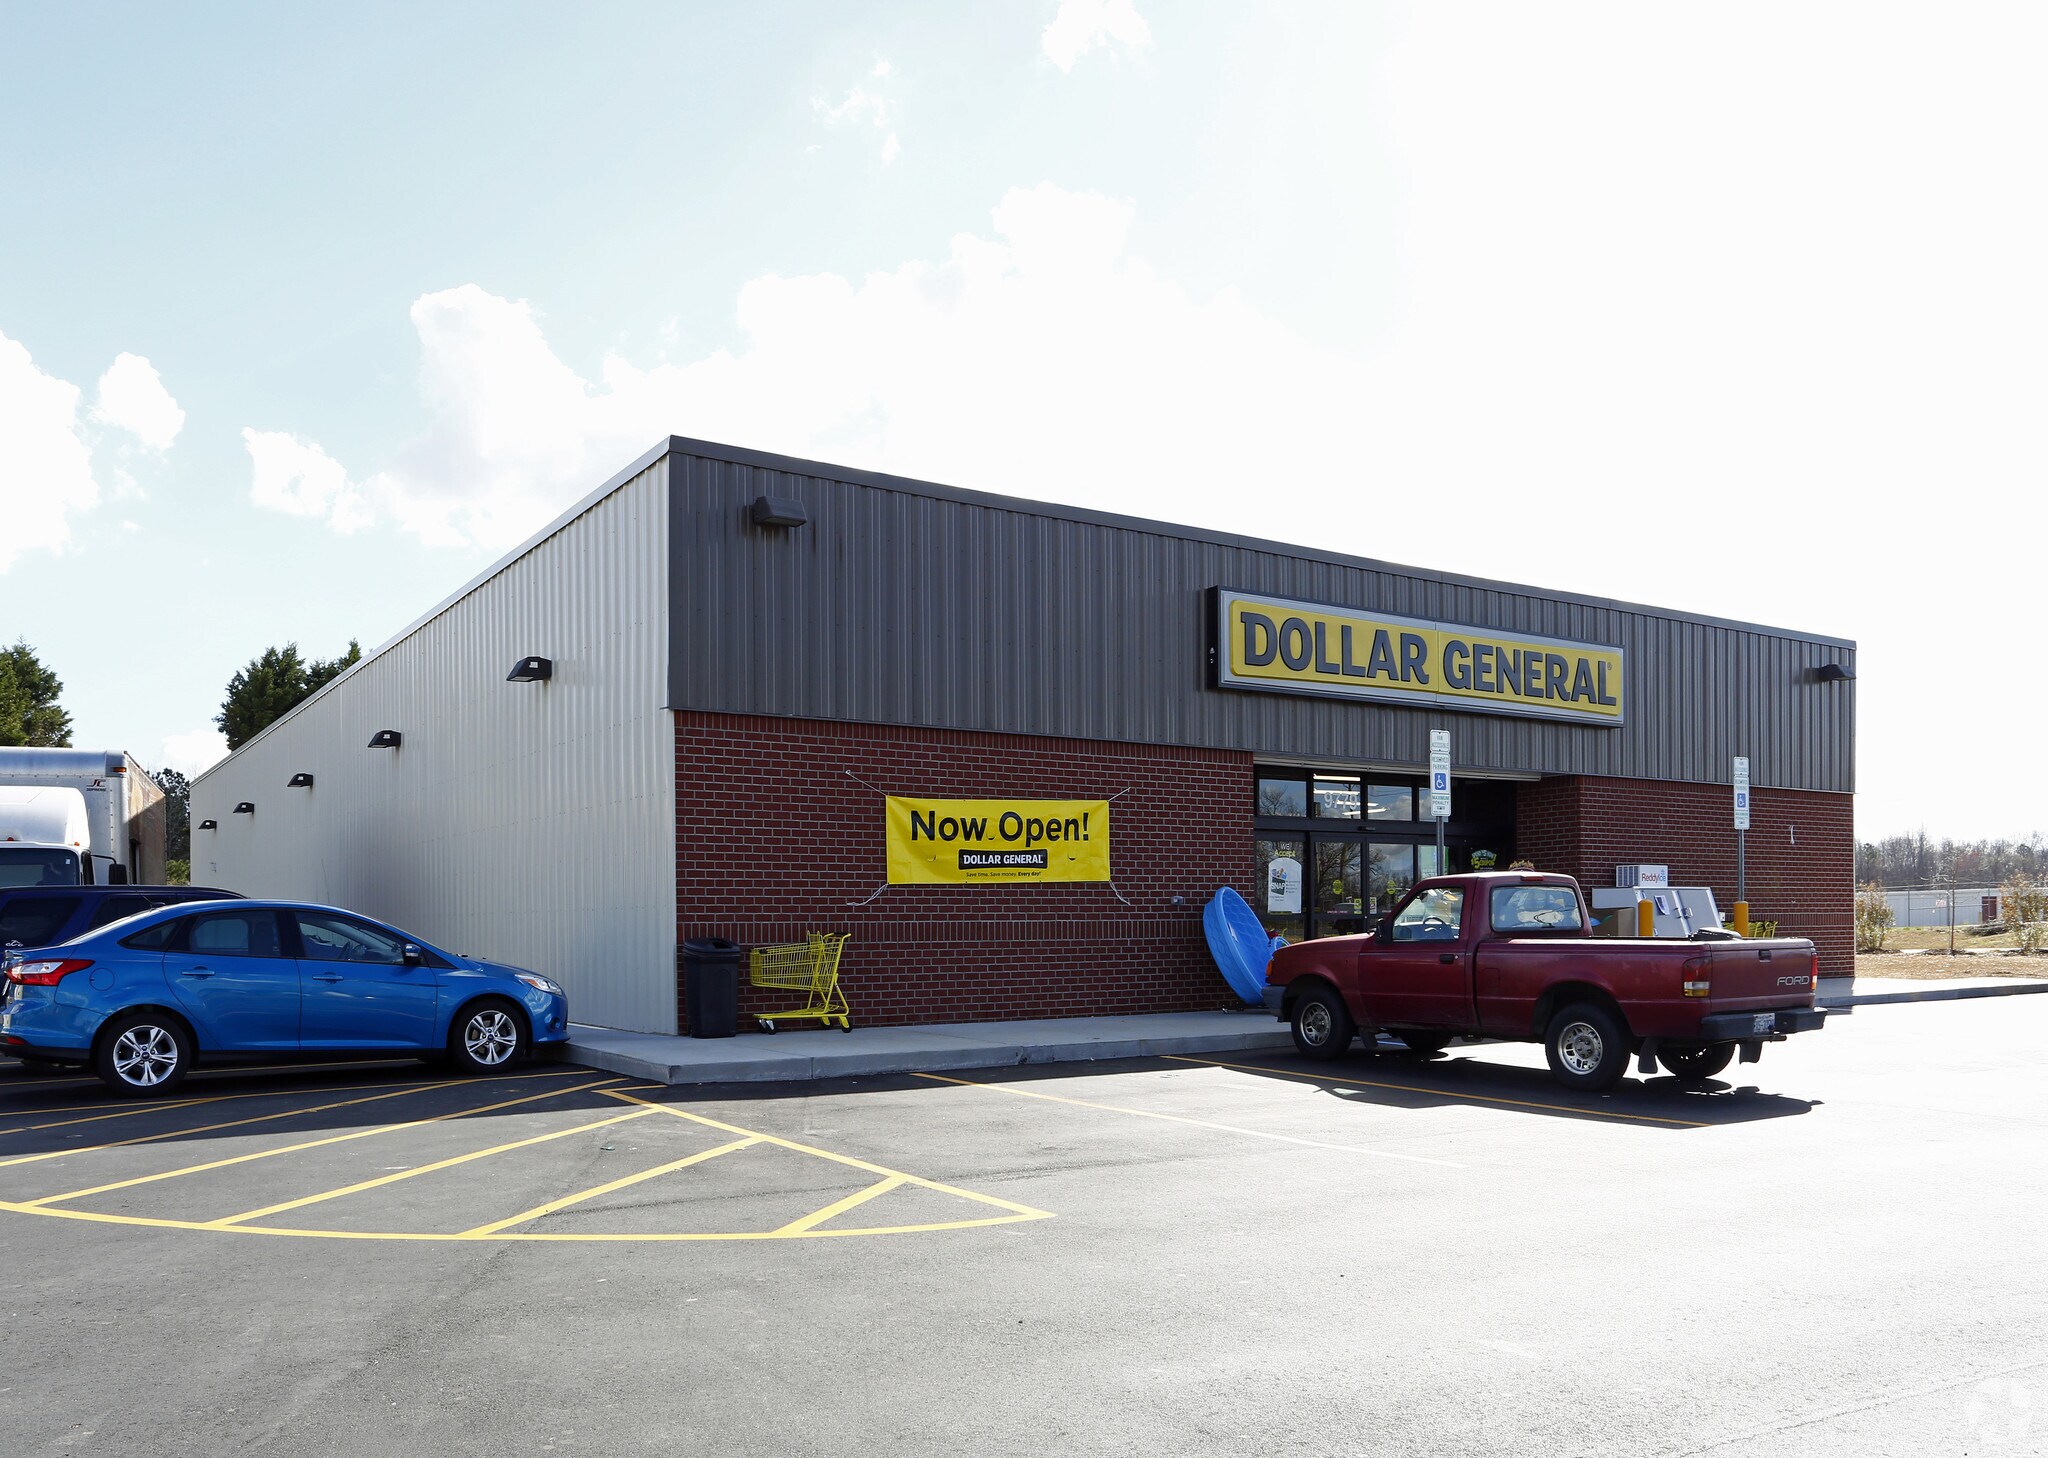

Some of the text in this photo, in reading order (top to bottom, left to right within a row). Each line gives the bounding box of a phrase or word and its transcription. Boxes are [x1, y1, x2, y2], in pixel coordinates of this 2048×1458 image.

[1240, 611, 1617, 707] DOLLAR GENERAL
[1324, 792, 1357, 810] 9779
[910, 810, 1089, 847] Now Open!
[963, 854, 1044, 865] DOLLAR GENERAL
[1271, 882, 1286, 890] SNAP
[1776, 975, 1810, 987] FORD
